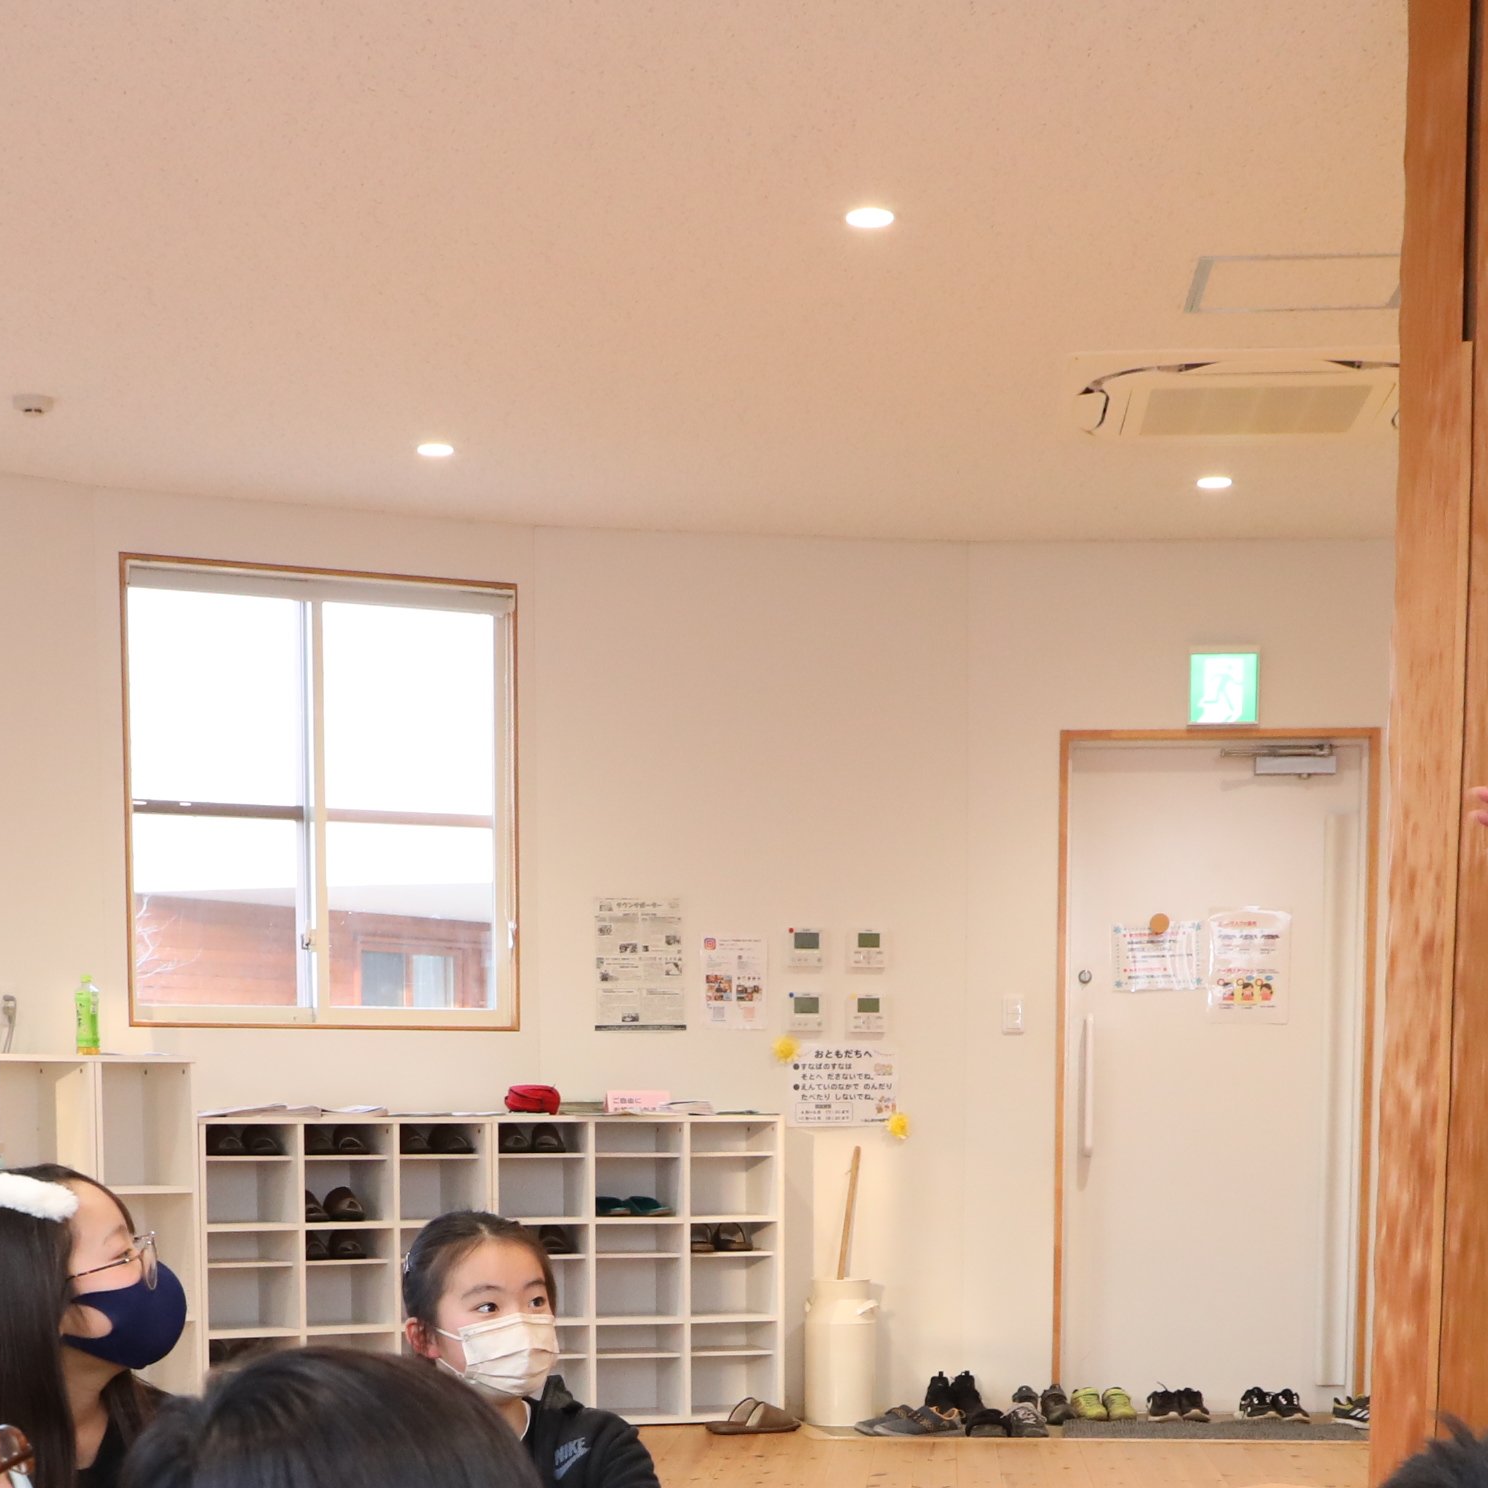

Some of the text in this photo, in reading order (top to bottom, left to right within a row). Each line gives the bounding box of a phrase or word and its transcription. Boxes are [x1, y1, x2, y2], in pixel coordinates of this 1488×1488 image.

[814, 1049, 873, 1059] おともだちへ
[554, 1437, 587, 1466] NIKE
